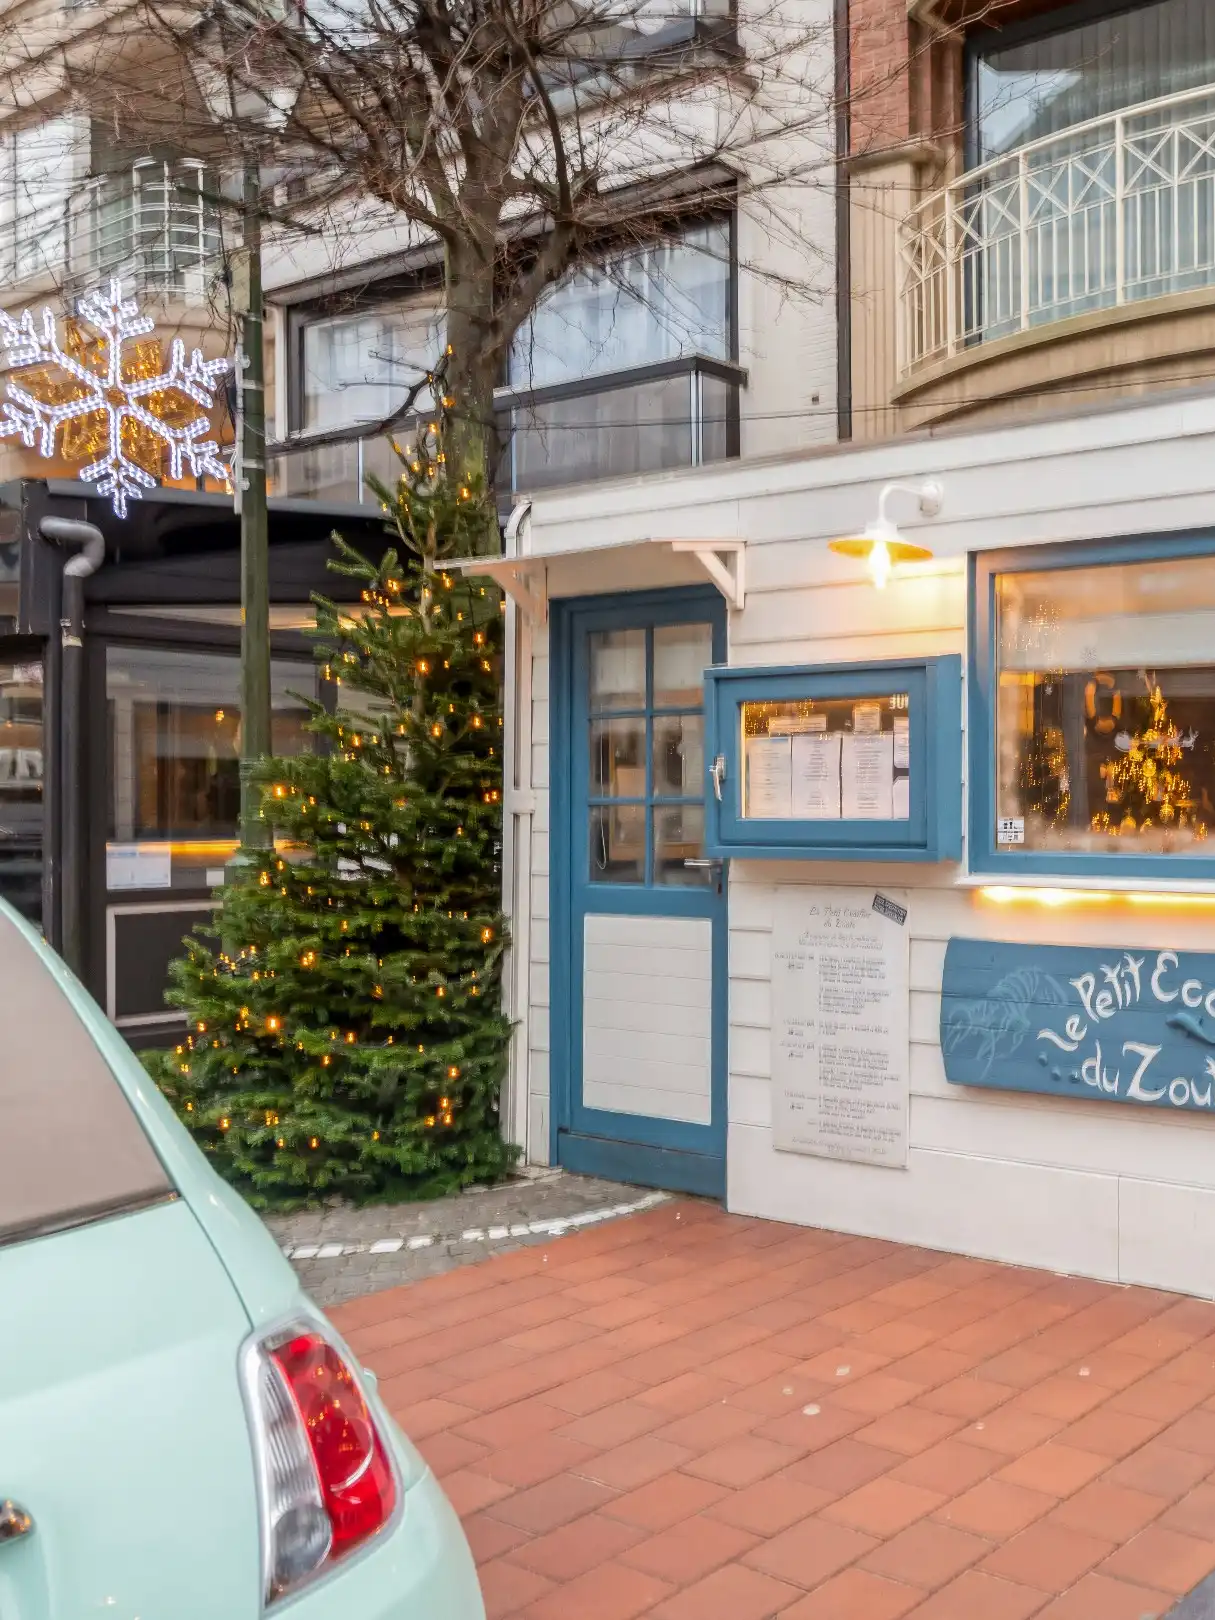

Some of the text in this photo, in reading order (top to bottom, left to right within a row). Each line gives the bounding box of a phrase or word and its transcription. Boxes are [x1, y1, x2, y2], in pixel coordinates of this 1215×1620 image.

[1036, 1014, 1088, 1052] Le
[1069, 952, 1145, 1023] Petit
[1080, 1038, 1119, 1096] du
